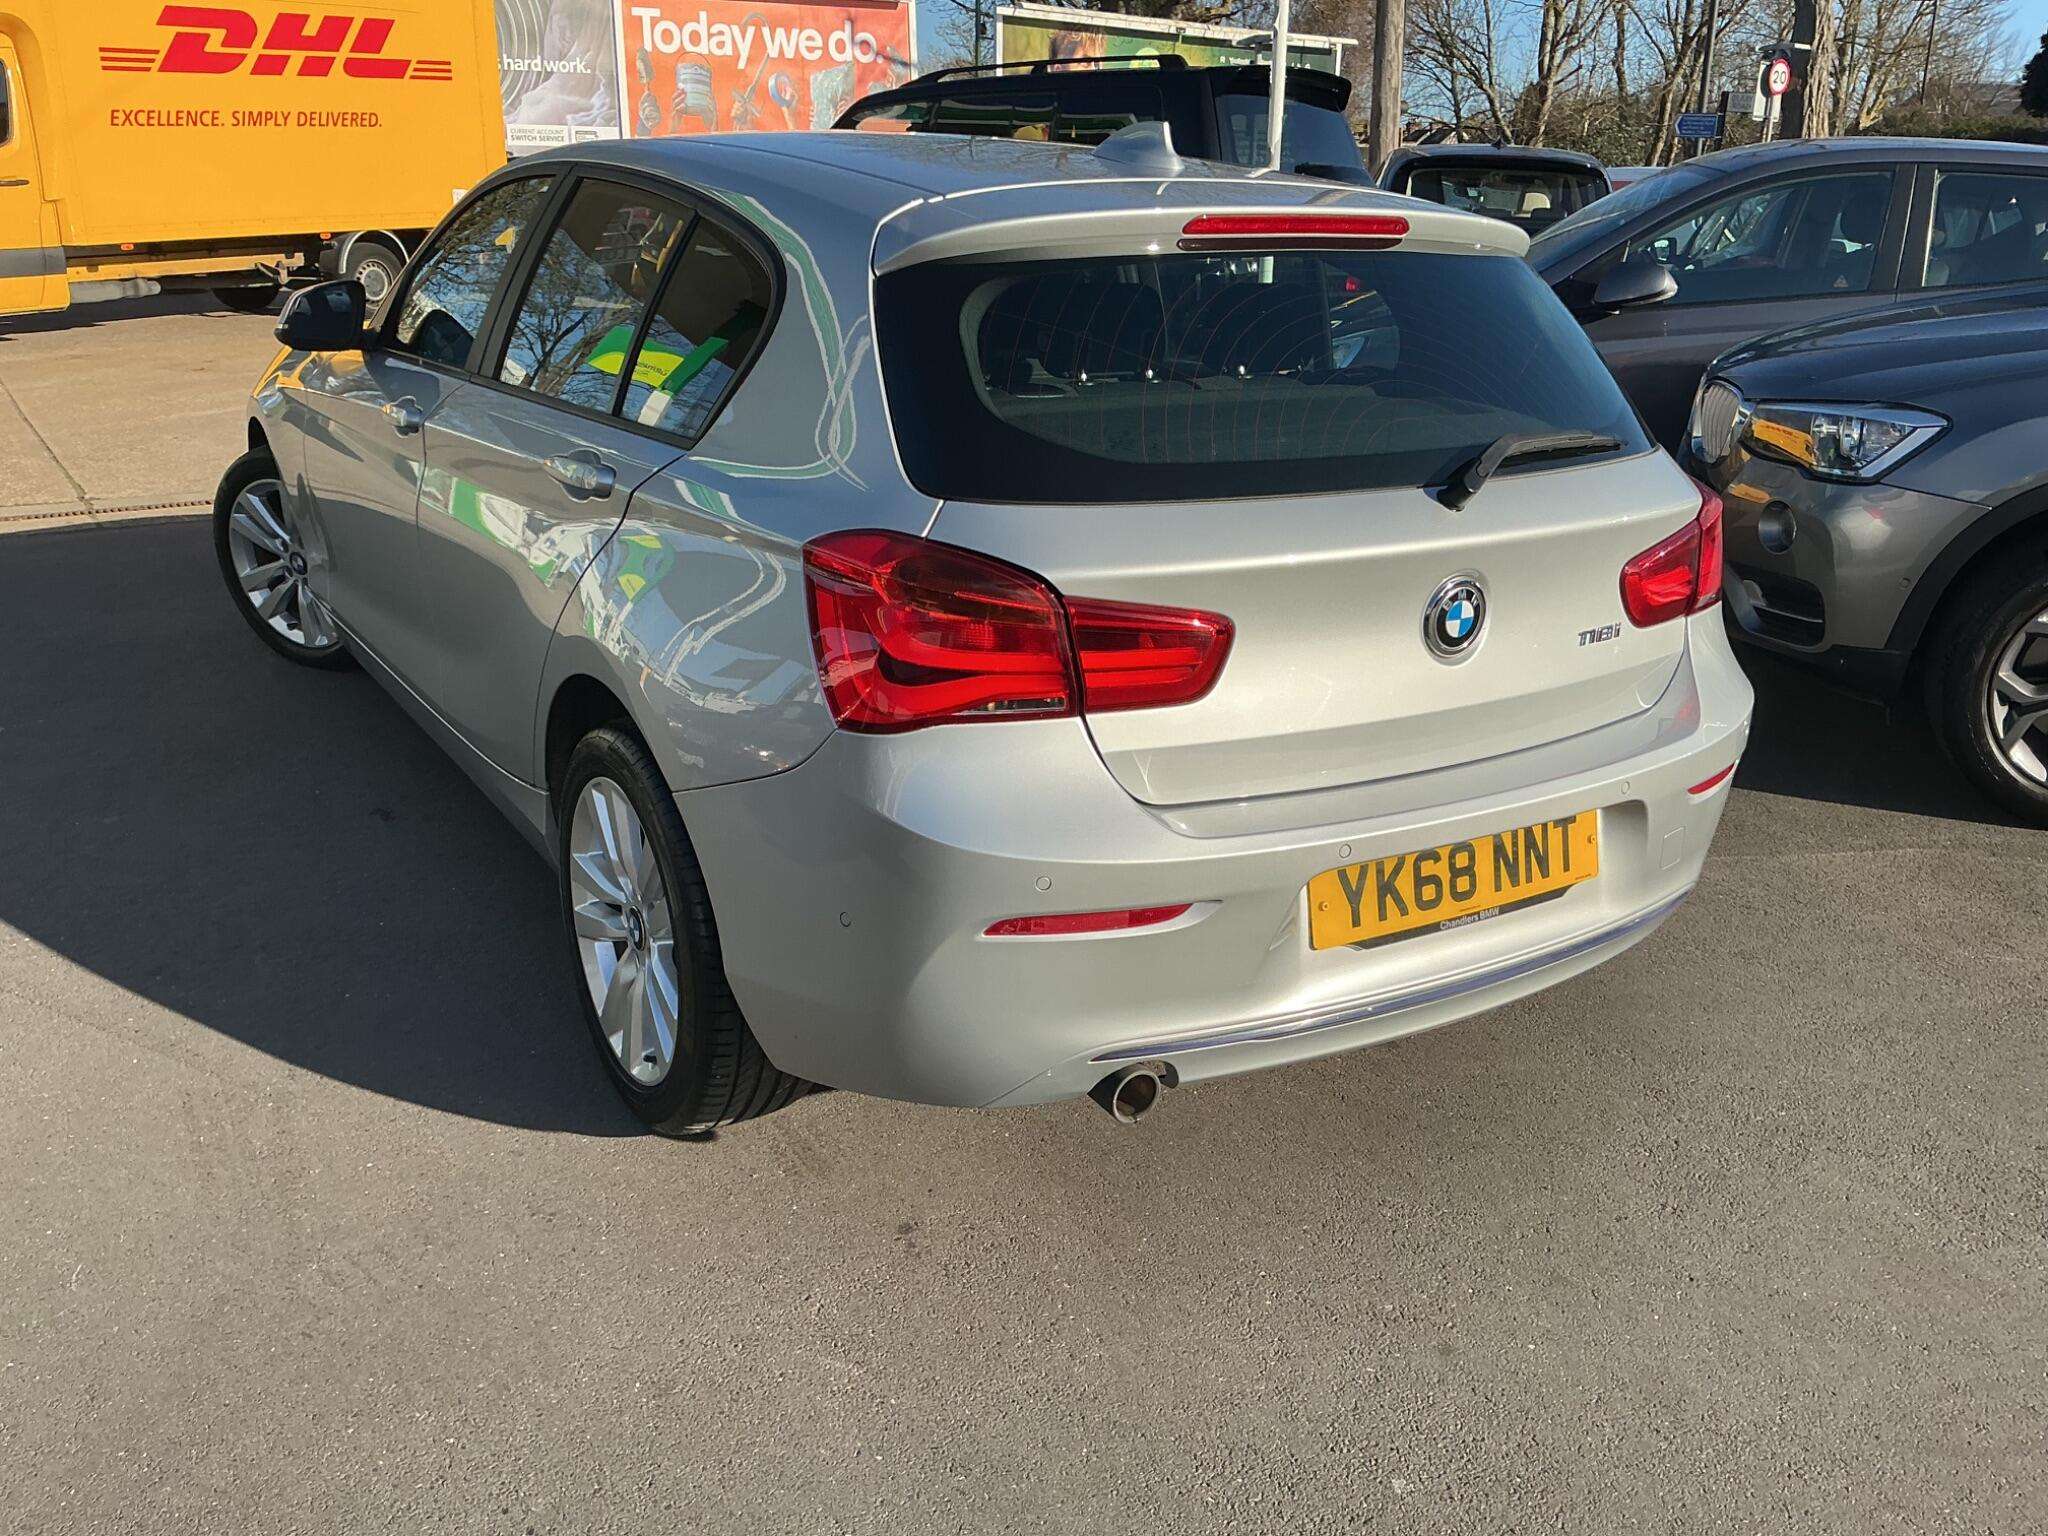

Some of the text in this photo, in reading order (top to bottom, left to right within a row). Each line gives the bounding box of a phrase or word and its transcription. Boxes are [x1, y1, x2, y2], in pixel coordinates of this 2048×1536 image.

[156, 5, 412, 80] DHL
[631, 6, 884, 69] Today we do.
[502, 53, 542, 71] hard
[543, 57, 591, 74] work.
[1773, 70, 1787, 84] 20
[110, 109, 383, 128] EXCELLENCE. SIMPLY DELIVERED.
[1442, 589, 1480, 611] BMW
[1337, 815, 1577, 928] YK68 NNT
[1440, 911, 1479, 930] Chandlers
[1479, 906, 1500, 920] BMW
